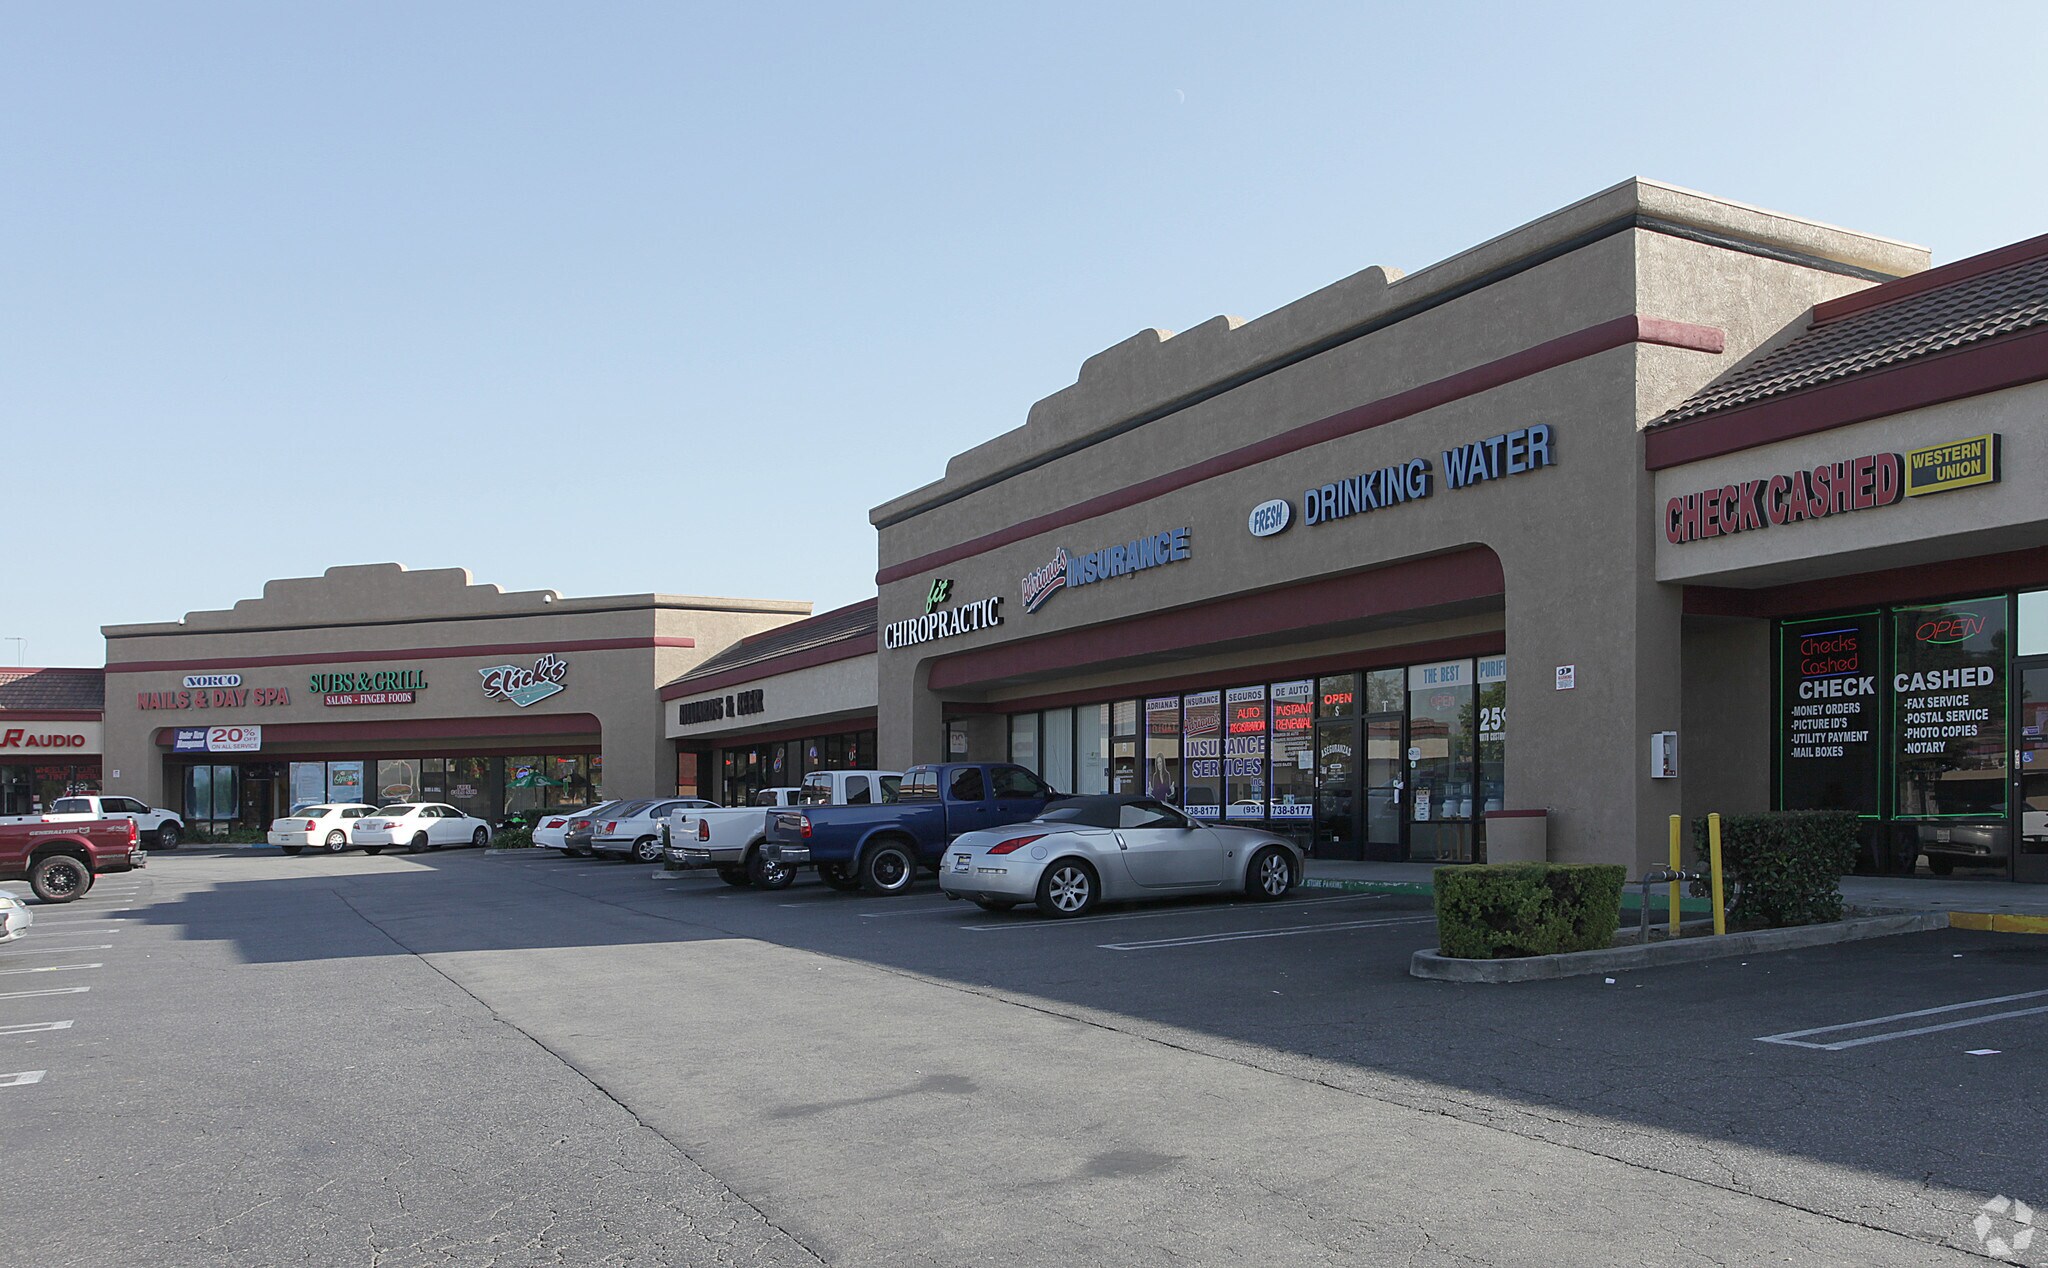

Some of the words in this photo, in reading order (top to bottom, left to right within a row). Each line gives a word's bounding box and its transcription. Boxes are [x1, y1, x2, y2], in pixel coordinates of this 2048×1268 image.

[1912, 441, 1981, 469] WESTERN
[1304, 458, 1430, 526] DRINKING
[1441, 423, 1550, 490] WATER
[1935, 459, 1981, 481] UNION
[1665, 479, 1763, 544] CHECK
[1766, 451, 1900, 526] CASHED
[1253, 501, 1284, 534] FRESH
[1021, 547, 1067, 606] Adriana's
[1066, 527, 1191, 588] INSURANCE
[925, 578, 949, 613] fit
[884, 596, 999, 650] CHIROPRACTIC
[1915, 617, 1986, 641] OPEN
[1800, 635, 1857, 656] Checks
[1801, 653, 1858, 675] Cashed
[186, 675, 239, 687] NORCO
[309, 672, 354, 693] SUBS
[356, 671, 371, 691] &
[373, 669, 427, 691] GRILL
[481, 653, 567, 698] Slick's
[1423, 668, 1438, 683] THE
[1441, 665, 1460, 682] BEST
[1799, 676, 1875, 699] CHECK
[1893, 666, 1994, 692] CASHED
[137, 690, 190, 710] NAILS
[194, 690, 208, 708] &
[212, 688, 248, 708] DAY
[253, 687, 290, 706] SPA
[326, 694, 353, 705] SALADS
[360, 693, 386, 704] FINGER
[388, 692, 412, 703] FOODS
[1228, 690, 1262, 702] SEGUROS
[1275, 687, 1286, 697] DE
[1288, 684, 1309, 695] AUTO
[1323, 693, 1353, 705] OPEN
[1904, 697, 1925, 709] -FAX
[1927, 694, 1969, 708] SERVICE
[1146, 699, 1178, 710] ADRIANA'S
[1185, 695, 1219, 706] INSURANCE
[1275, 701, 1314, 717] INSTANT
[1791, 704, 1824, 717] -MONEY
[1825, 702, 1861, 715] ORDERS
[1237, 706, 1260, 719] AUTO
[1904, 711, 1944, 724] -POSTAL
[1946, 708, 1989, 722] SERVICE
[1275, 717, 1313, 730] RENEWAL
[1791, 718, 1830, 730] -PICTURE
[1831, 717, 1848, 729] ID'S
[1904, 727, 1940, 739] -PHOTO
[1941, 724, 1978, 737] COPIES
[25, 734, 86, 747] AUDIO
[1791, 732, 1827, 744] -UTILITY
[1827, 730, 1869, 743] PAYMENT
[1791, 747, 1814, 758] -MAIL
[1815, 746, 1844, 757] BOXES
[1904, 741, 1946, 754] -NOTARY
[1191, 757, 1262, 778] SERVICES
[1243, 805, 1264, 815] (951)
[1272, 805, 1311, 815] 738-8177
